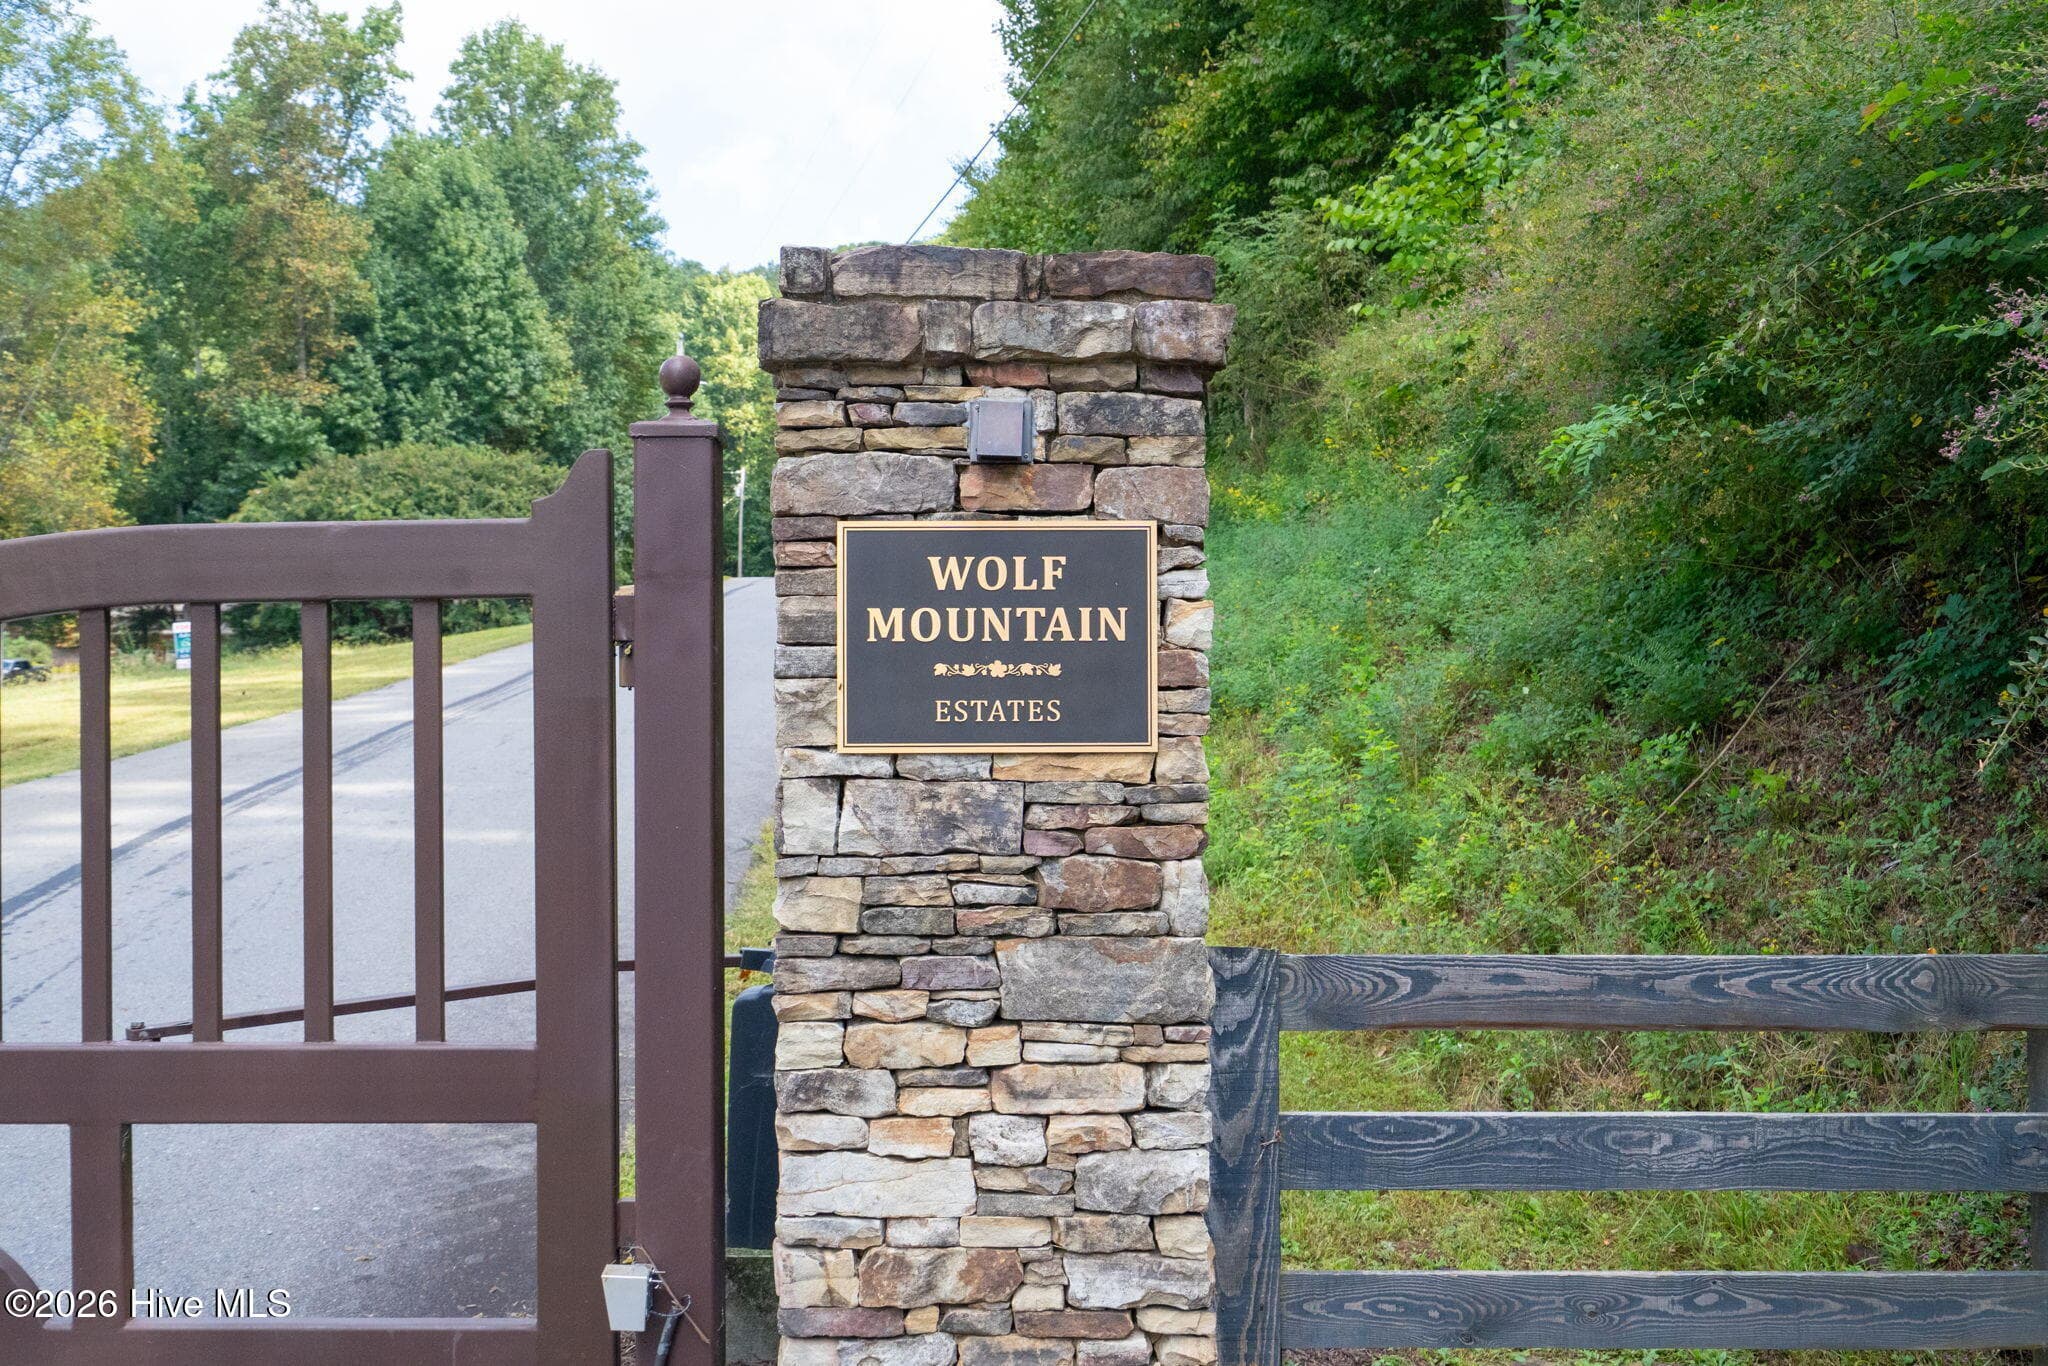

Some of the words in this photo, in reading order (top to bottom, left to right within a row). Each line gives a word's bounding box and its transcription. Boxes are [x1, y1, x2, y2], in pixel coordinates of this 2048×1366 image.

[927, 556, 1067, 591] WOLF
[866, 606, 1129, 642] MOUNTAIN
[935, 700, 1062, 722] ESTATES
